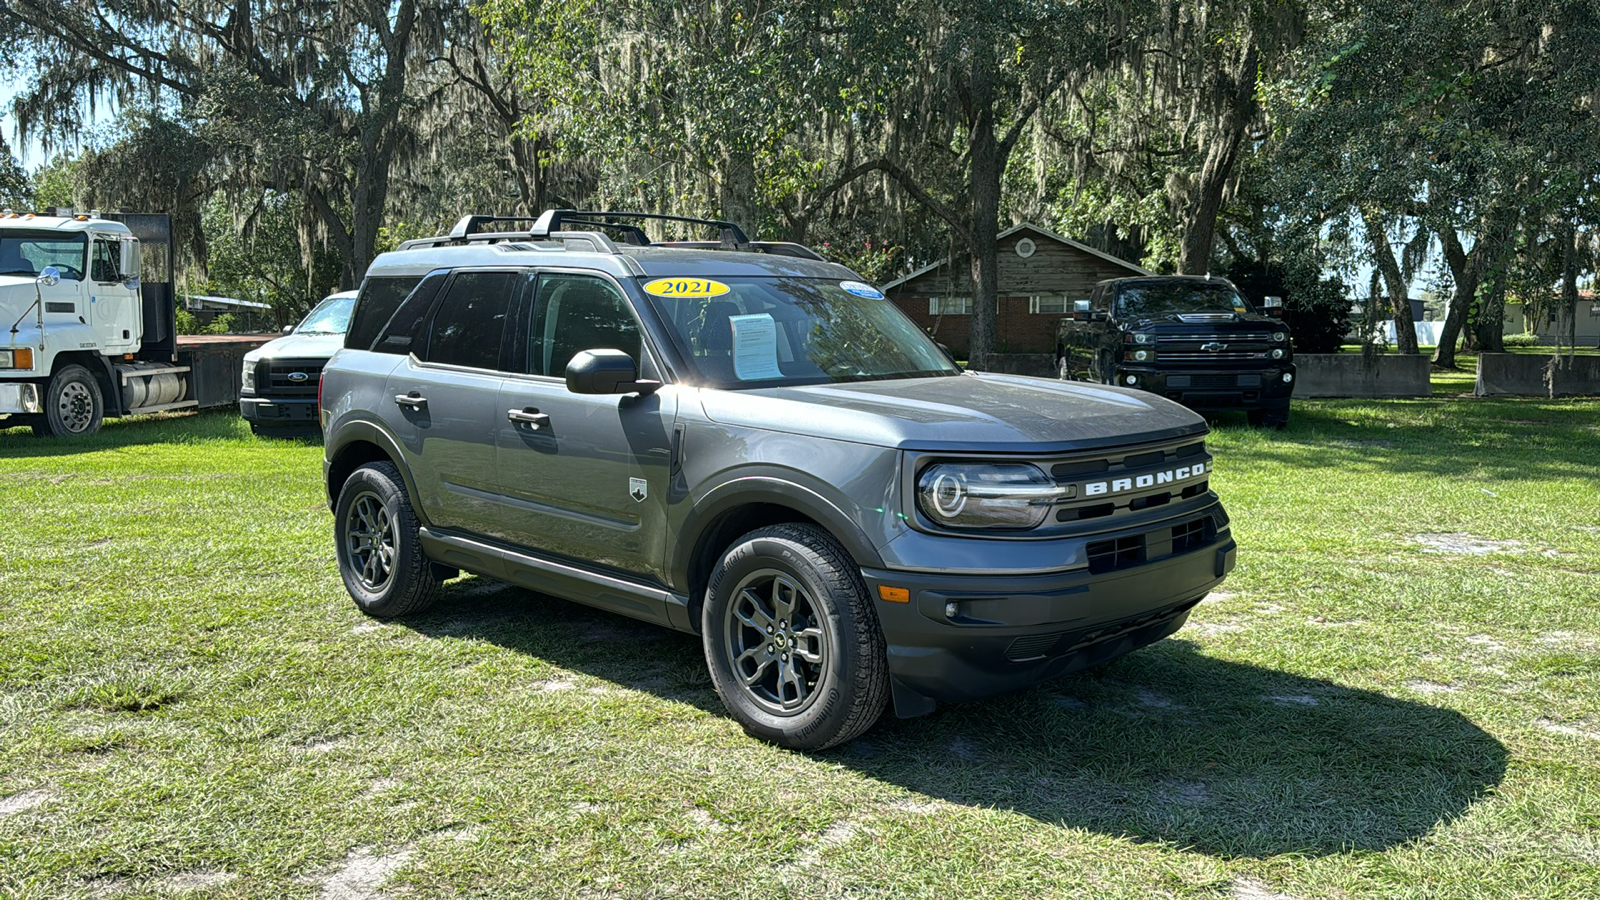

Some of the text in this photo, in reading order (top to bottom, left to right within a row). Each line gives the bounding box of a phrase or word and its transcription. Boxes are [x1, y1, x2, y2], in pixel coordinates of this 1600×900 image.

[662, 281, 713, 294] 2021
[1085, 463, 1204, 496] BRONCO
[709, 551, 741, 602] Continental
[801, 688, 840, 739] Continental
